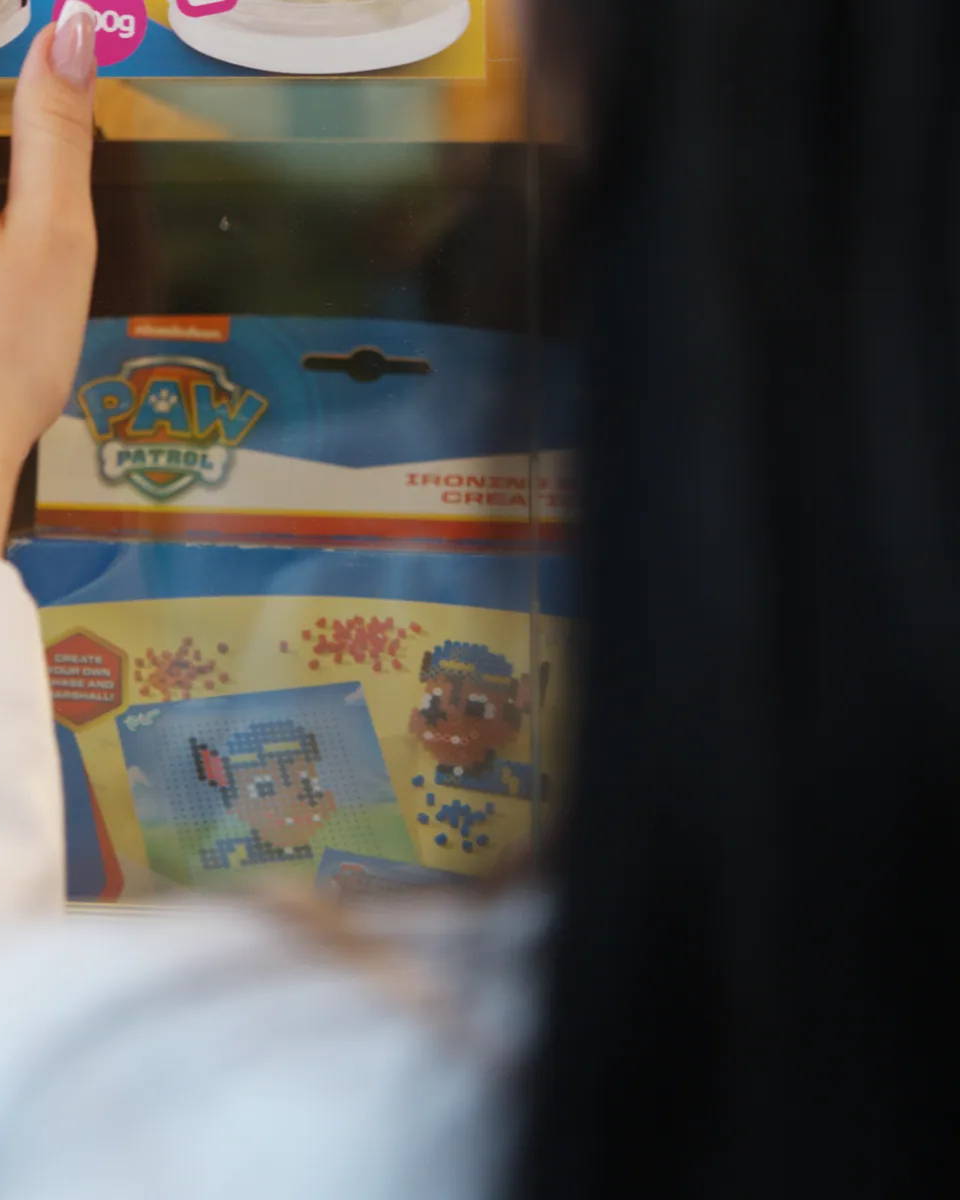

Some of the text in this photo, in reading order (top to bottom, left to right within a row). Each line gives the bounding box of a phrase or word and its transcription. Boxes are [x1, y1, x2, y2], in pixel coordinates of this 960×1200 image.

[79, 375, 269, 445] PAW
[116, 448, 214, 471] PATROL
[54, 654, 103, 664] CREATE
